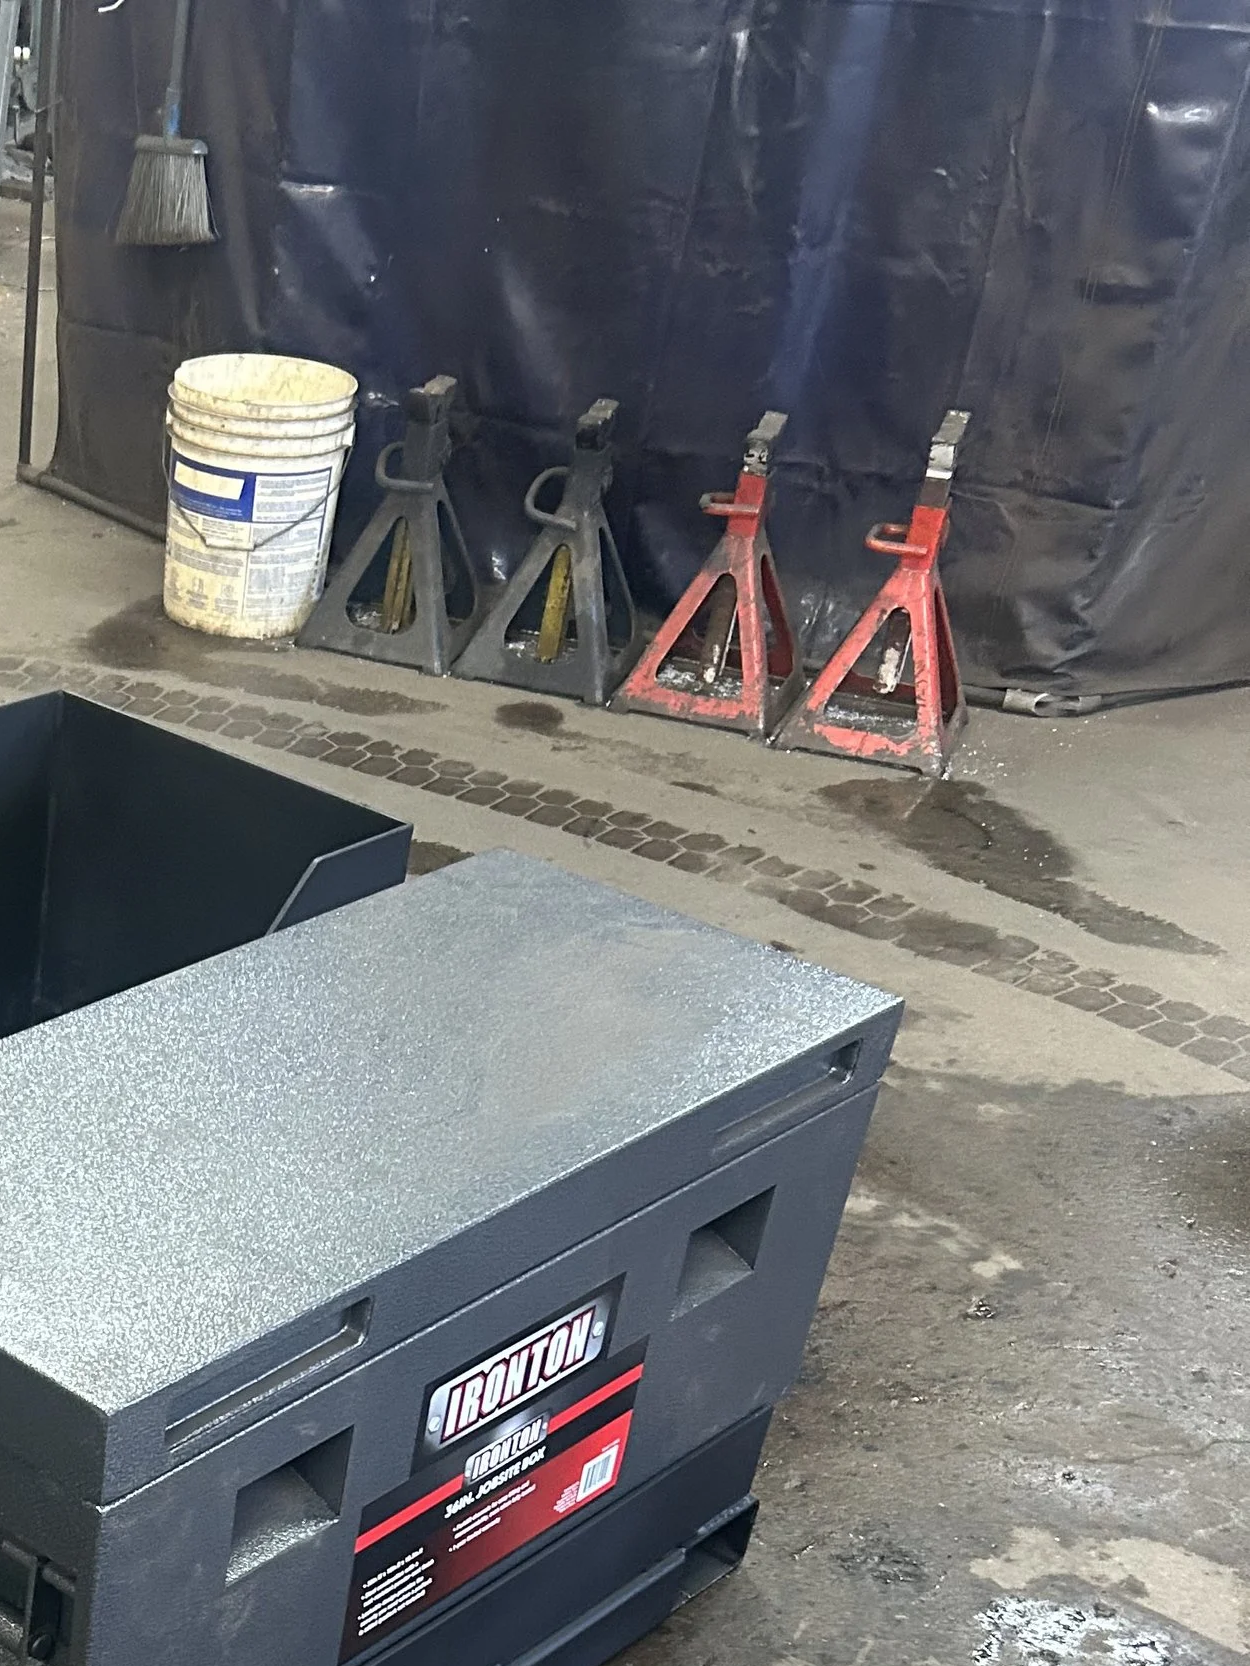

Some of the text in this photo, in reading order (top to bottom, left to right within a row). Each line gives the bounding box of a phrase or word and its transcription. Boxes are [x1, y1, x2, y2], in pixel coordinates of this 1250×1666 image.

[440, 1306, 596, 1444] IRONTON
[471, 1417, 543, 1480] IRONTON
[475, 1461, 521, 1500] JOBSITE
[520, 1445, 546, 1471] BOX
